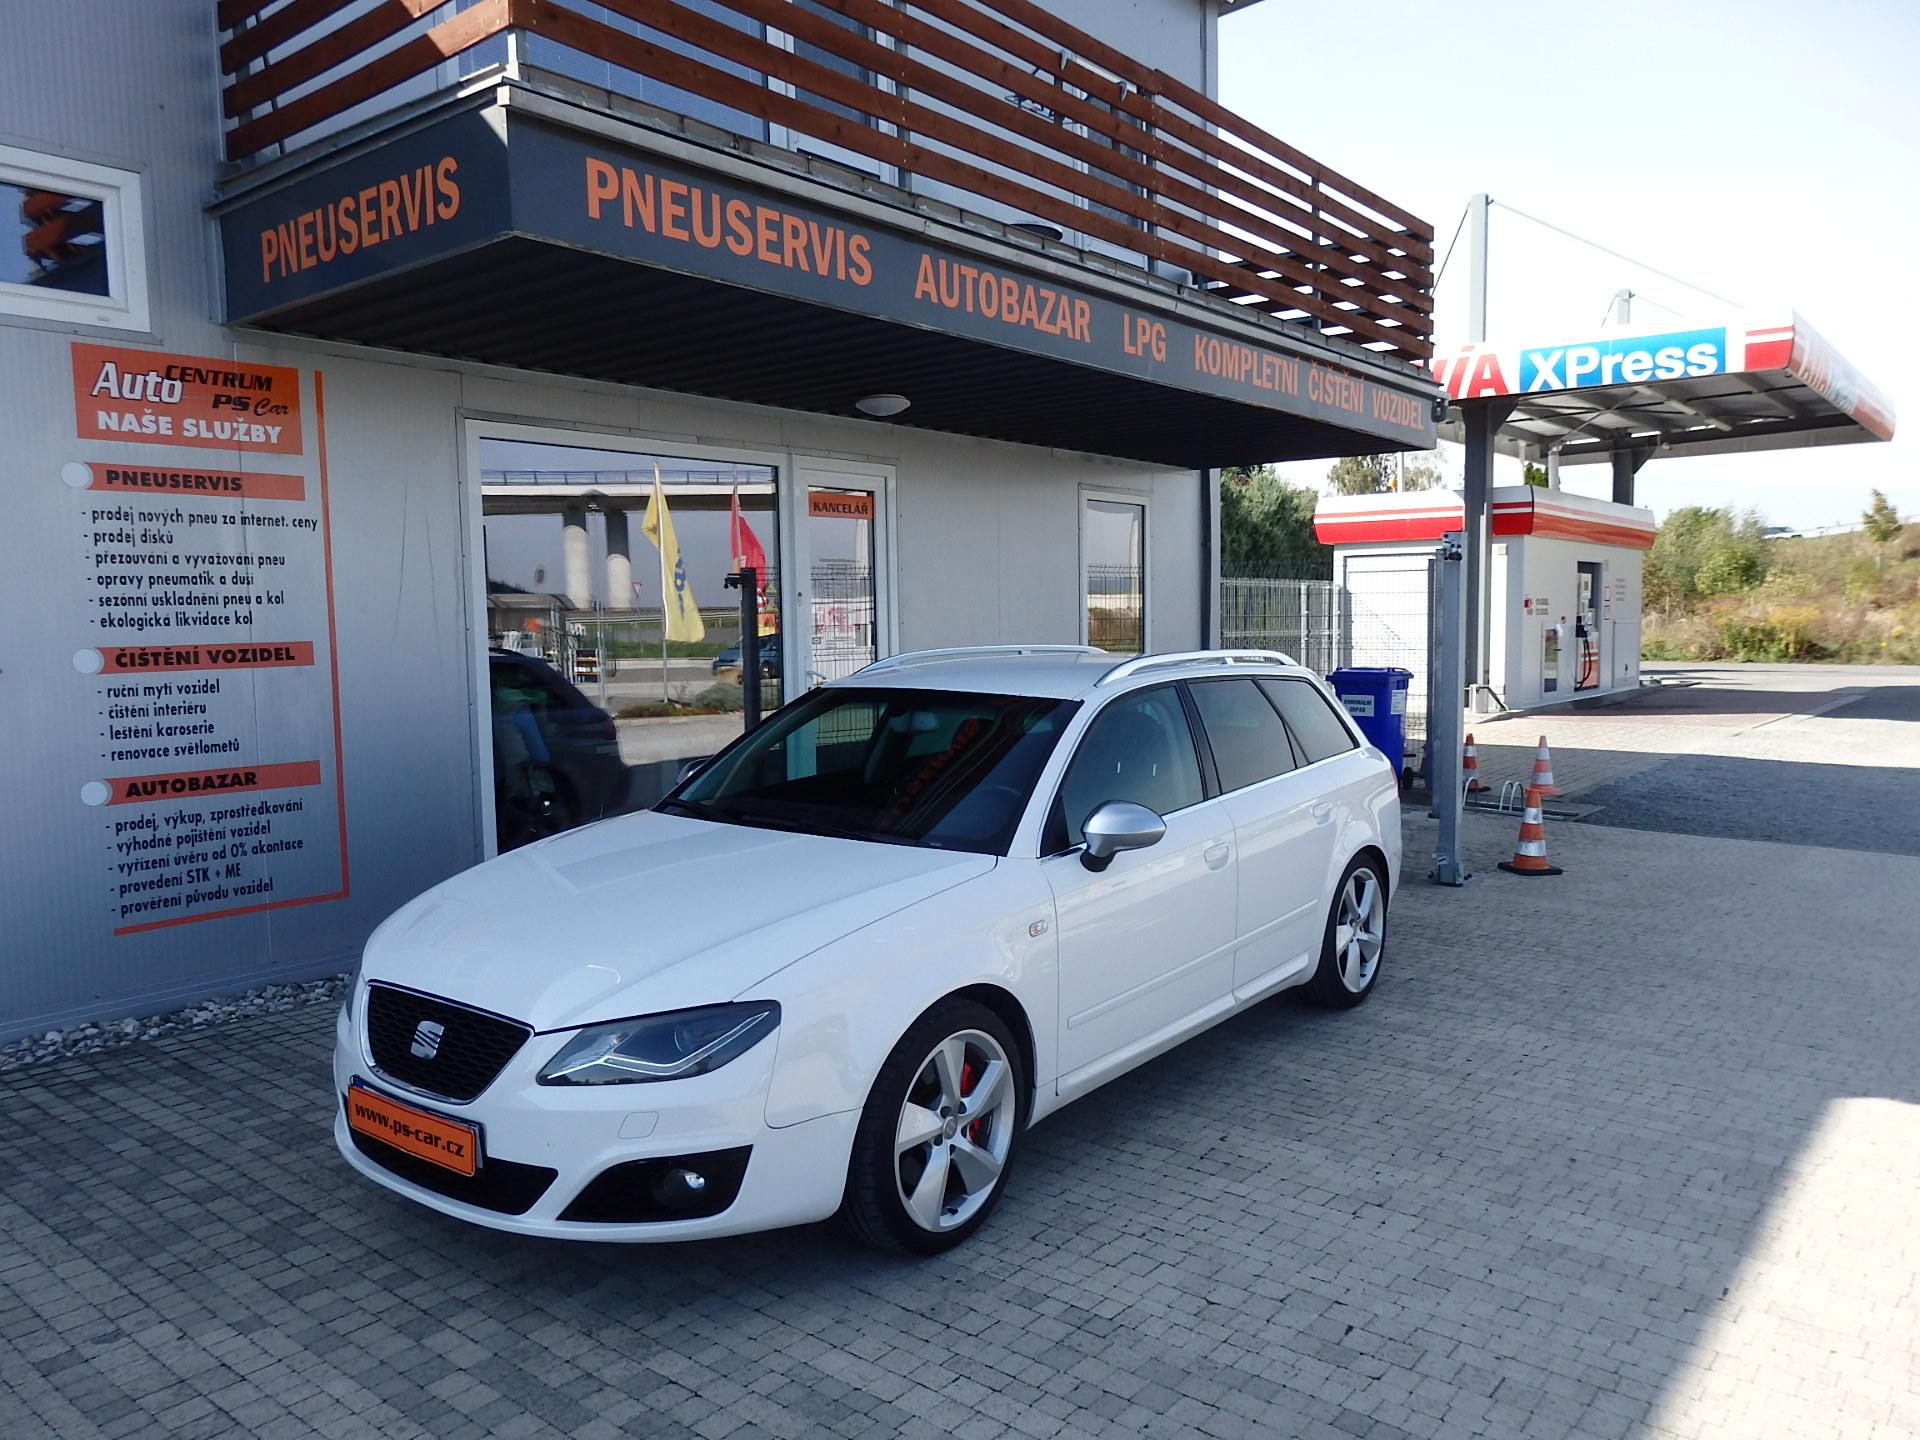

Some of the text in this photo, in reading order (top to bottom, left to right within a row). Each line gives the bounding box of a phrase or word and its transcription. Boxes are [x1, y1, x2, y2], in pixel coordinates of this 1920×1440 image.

[261, 156, 461, 283] PNEUSERVIS
[585, 156, 1424, 431] PNEUSERVIS AUTOBAZAR LPG KOMPLETNÍ ČIŠTĚNÍ VOZIDEL
[1527, 343, 1718, 392] XPress
[91, 361, 272, 404] Auto CENTRUM
[212, 394, 290, 416] PS Car
[97, 408, 282, 444] NAŠE SLUŽBY
[106, 470, 242, 491] PNEUSERVIS
[92, 506, 318, 532] prodej nových pneu za internet. ceny
[813, 502, 868, 515] KANCELÁŘ
[94, 527, 135, 547] prodej
[96, 550, 286, 568] přezouvání a vyvažování pneu
[97, 575, 143, 589] opravy
[149, 570, 215, 589] pneumatik
[219, 575, 226, 585] a
[99, 589, 284, 608] sezónní uskladnění pneu a kol
[100, 610, 252, 630] ekologická likvidace kol
[115, 646, 295, 668] ČIŠTĚNÍ VOZIDEL
[107, 678, 220, 699] ruční mytí vozidel
[109, 700, 206, 719] čištění interiéru
[109, 719, 215, 740] leštění karoserie
[111, 738, 240, 761] renovace světlometů
[125, 771, 257, 798] AUTOBAZAR
[115, 798, 303, 836] prodej, výkup, zprostředkování
[116, 819, 271, 856] výhodné pojištění vozidel
[118, 839, 304, 876] vyřízení úvěru od 0% akontace
[119, 872, 183, 898] provedení
[187, 866, 211, 883] STK
[225, 862, 241, 879] ME
[120, 876, 274, 918] prověření původu vozidel
[354, 1103, 465, 1158] www.ps-car.cz
